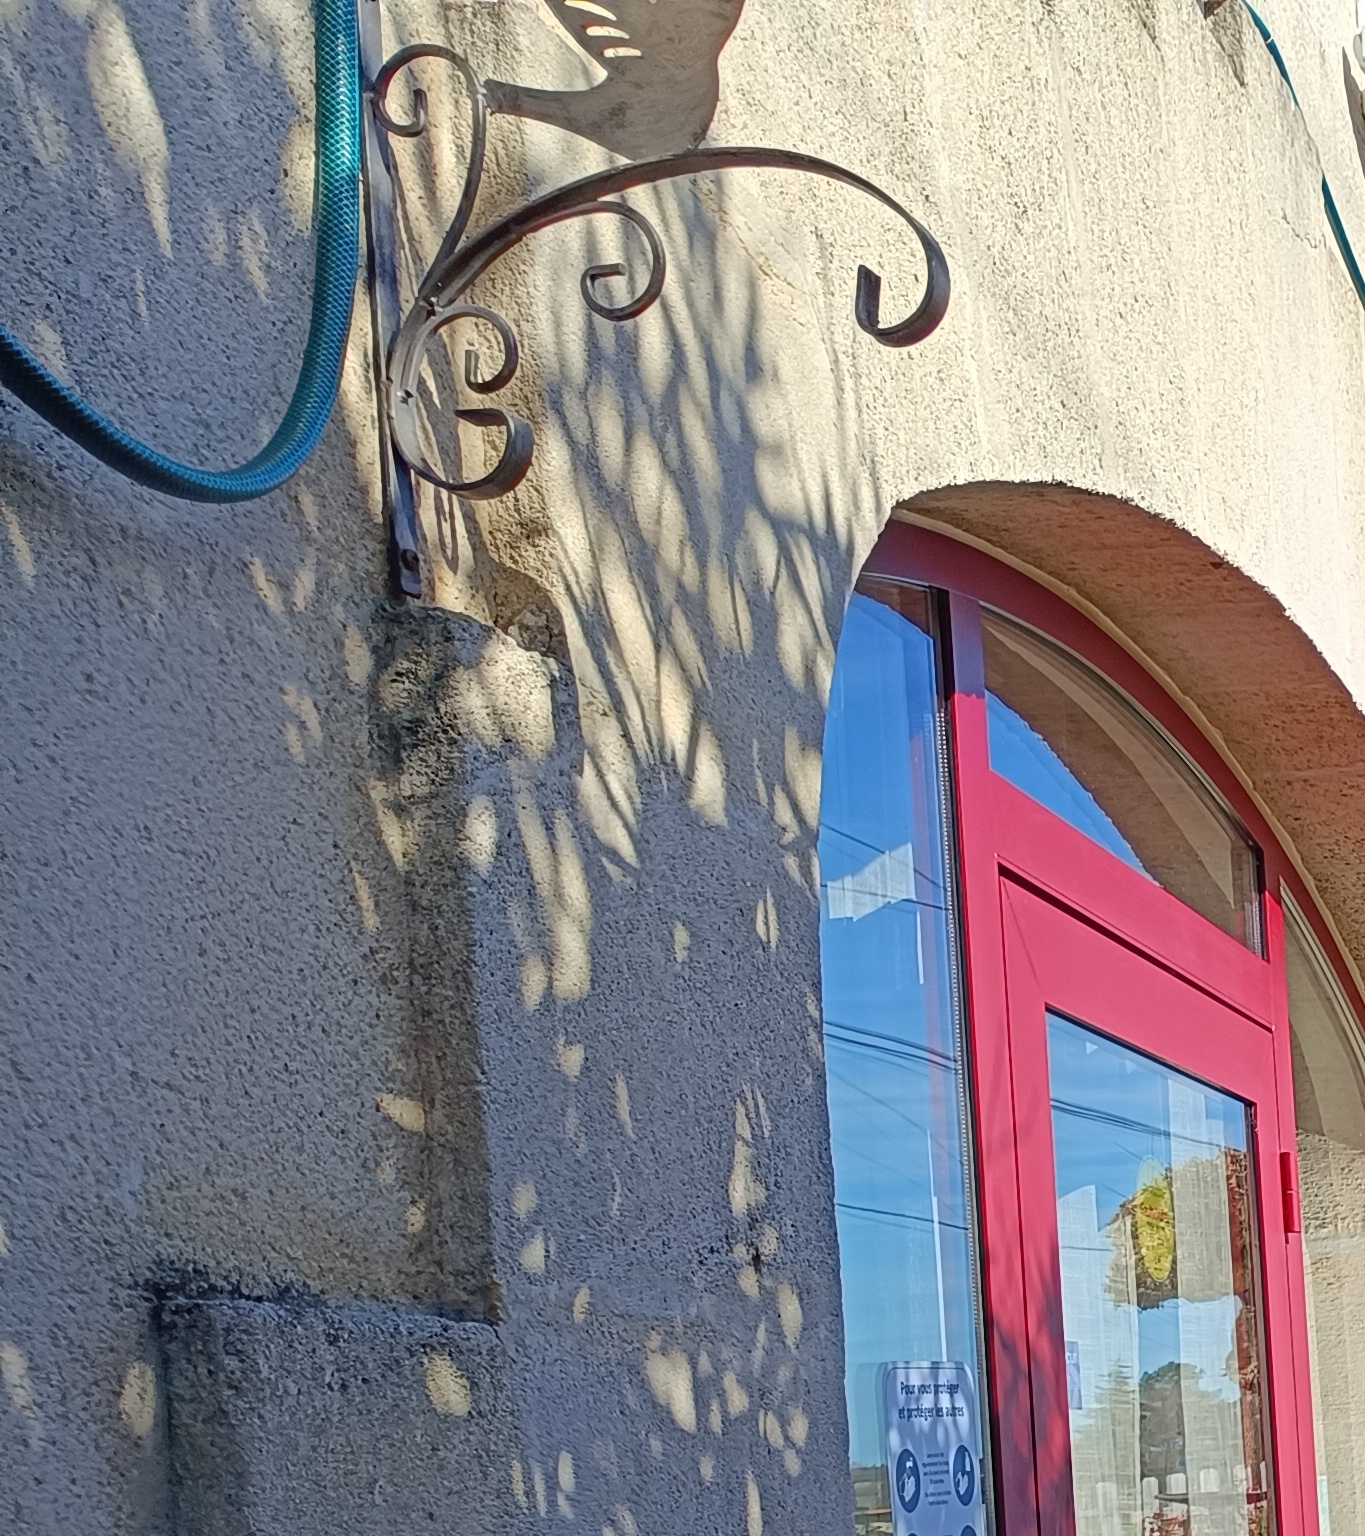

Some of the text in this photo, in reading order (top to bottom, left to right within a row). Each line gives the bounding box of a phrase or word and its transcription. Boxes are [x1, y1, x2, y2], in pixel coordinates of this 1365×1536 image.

[900, 1381, 916, 1395] Pour
[917, 1383, 932, 1395] vous
[898, 1406, 906, 1420] et
[906, 1403, 935, 1422] protéger
[945, 1405, 964, 1418] autres
